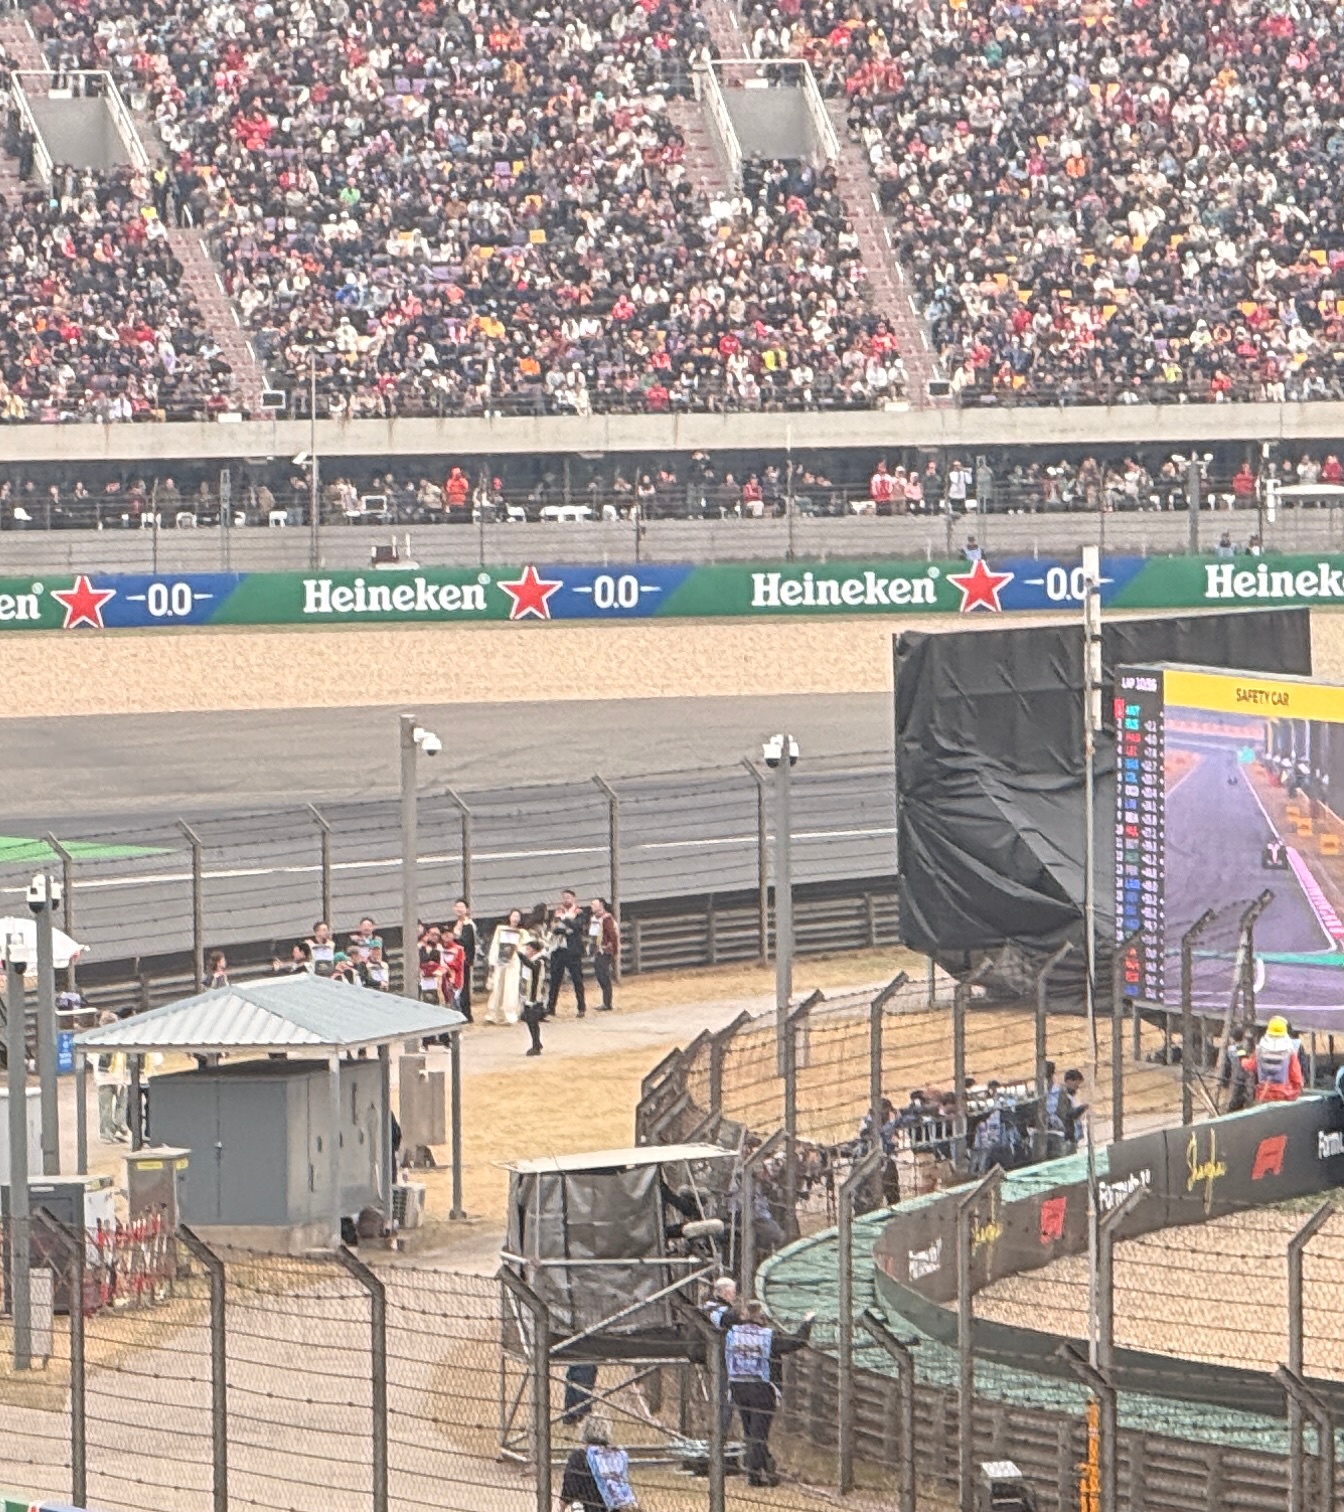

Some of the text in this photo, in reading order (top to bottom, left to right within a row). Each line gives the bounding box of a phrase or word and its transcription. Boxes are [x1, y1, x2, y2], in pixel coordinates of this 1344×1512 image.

[303, 577, 487, 613] Heineken
[751, 570, 937, 607] Heineken
[1236, 688, 1289, 706] SAFETY CAR
